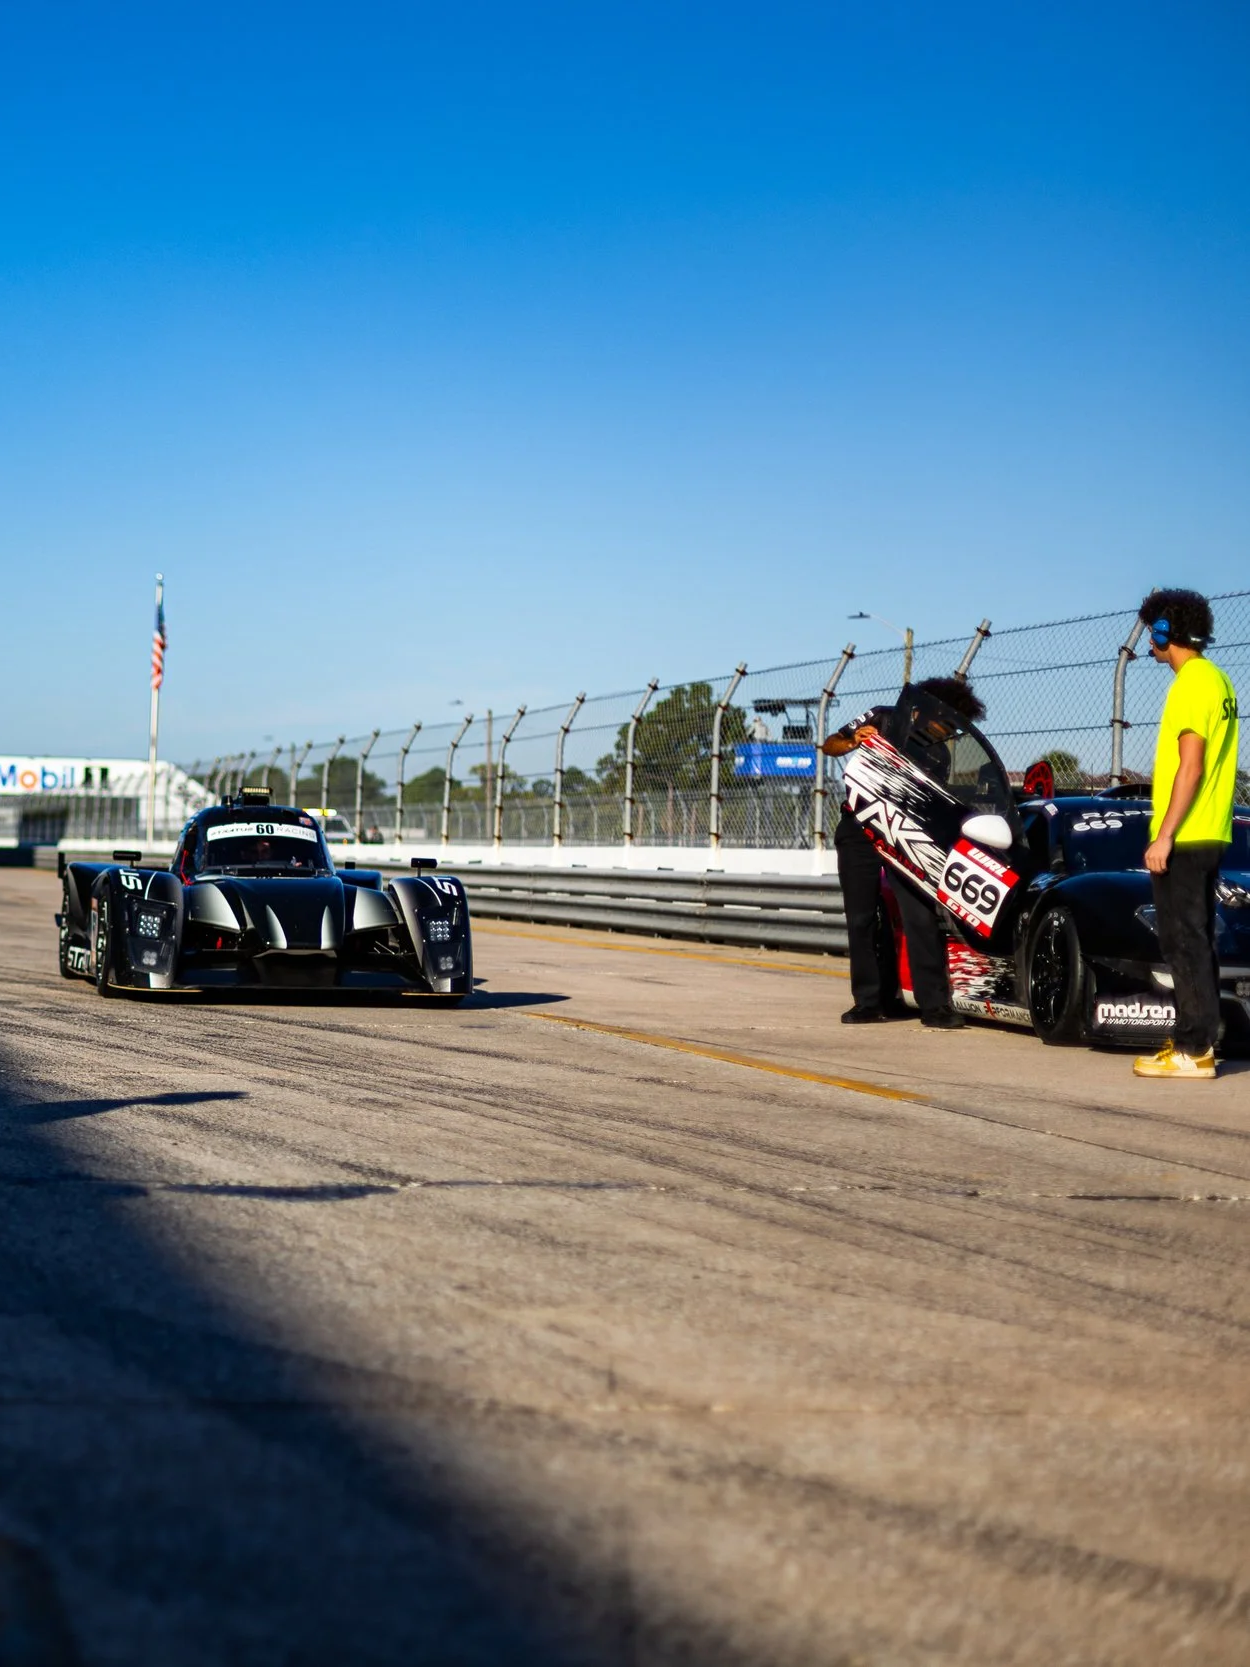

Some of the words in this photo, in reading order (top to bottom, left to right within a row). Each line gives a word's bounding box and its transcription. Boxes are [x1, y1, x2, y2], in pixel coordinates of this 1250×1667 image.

[256, 824, 275, 835] 60
[1073, 819, 1123, 832] 669
[967, 847, 1011, 877] WRL
[944, 861, 1001, 916] 669
[946, 898, 981, 927] GTO
[1097, 1002, 1177, 1024] madsen
[1113, 1018, 1177, 1027] MOTORSPORTS
